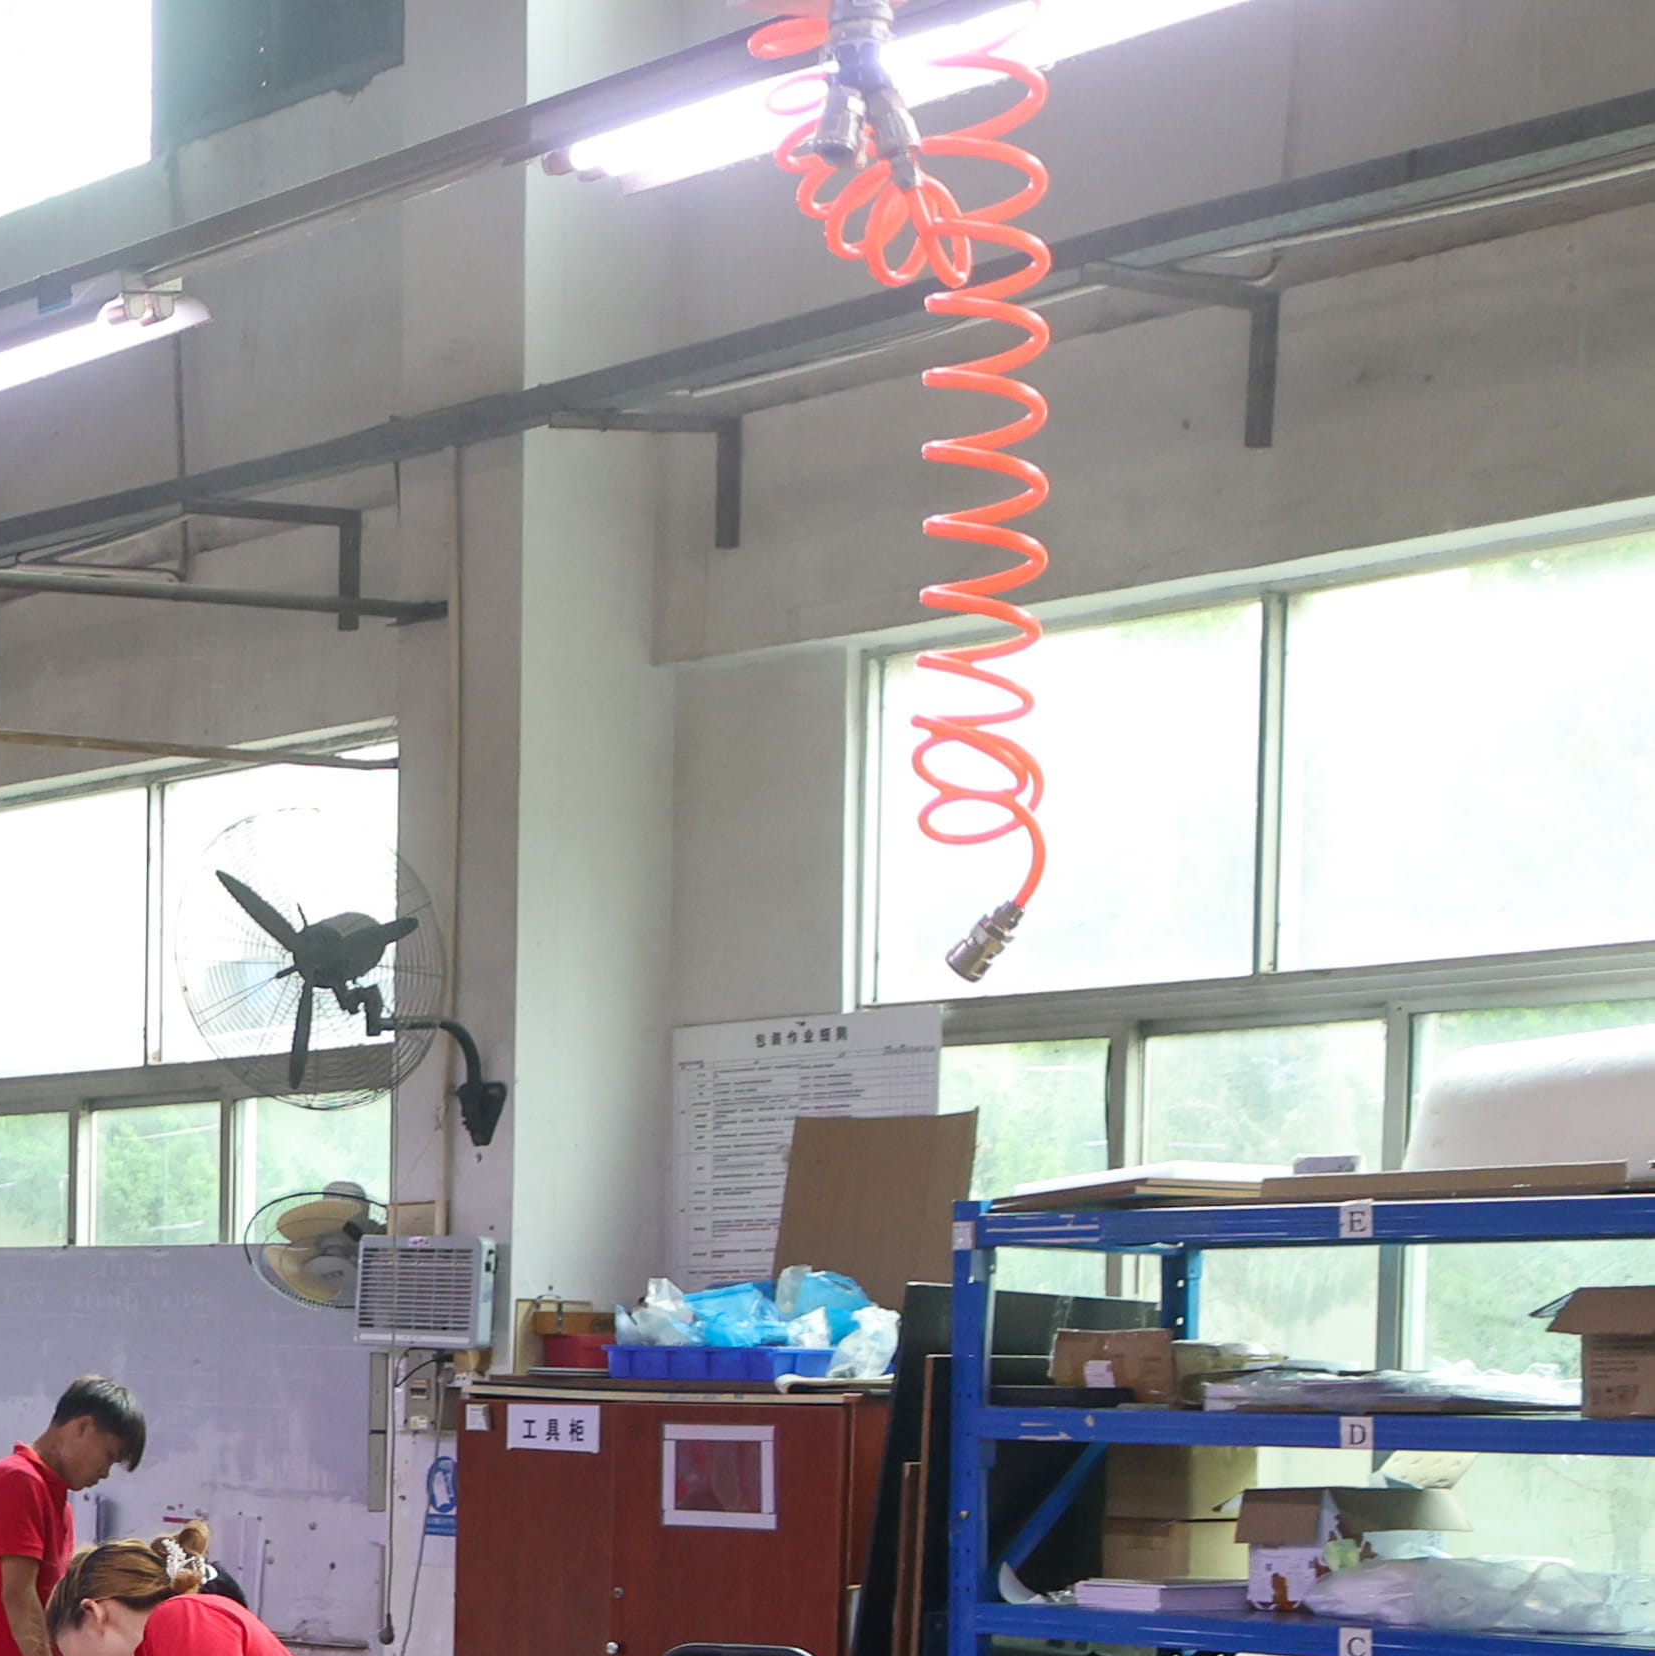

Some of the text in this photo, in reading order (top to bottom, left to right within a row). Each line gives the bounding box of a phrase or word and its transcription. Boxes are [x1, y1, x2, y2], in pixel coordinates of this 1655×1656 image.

[1349, 1211, 1366, 1233] E
[522, 1418, 585, 1442] 工具柜
[1349, 1424, 1367, 1445] D
